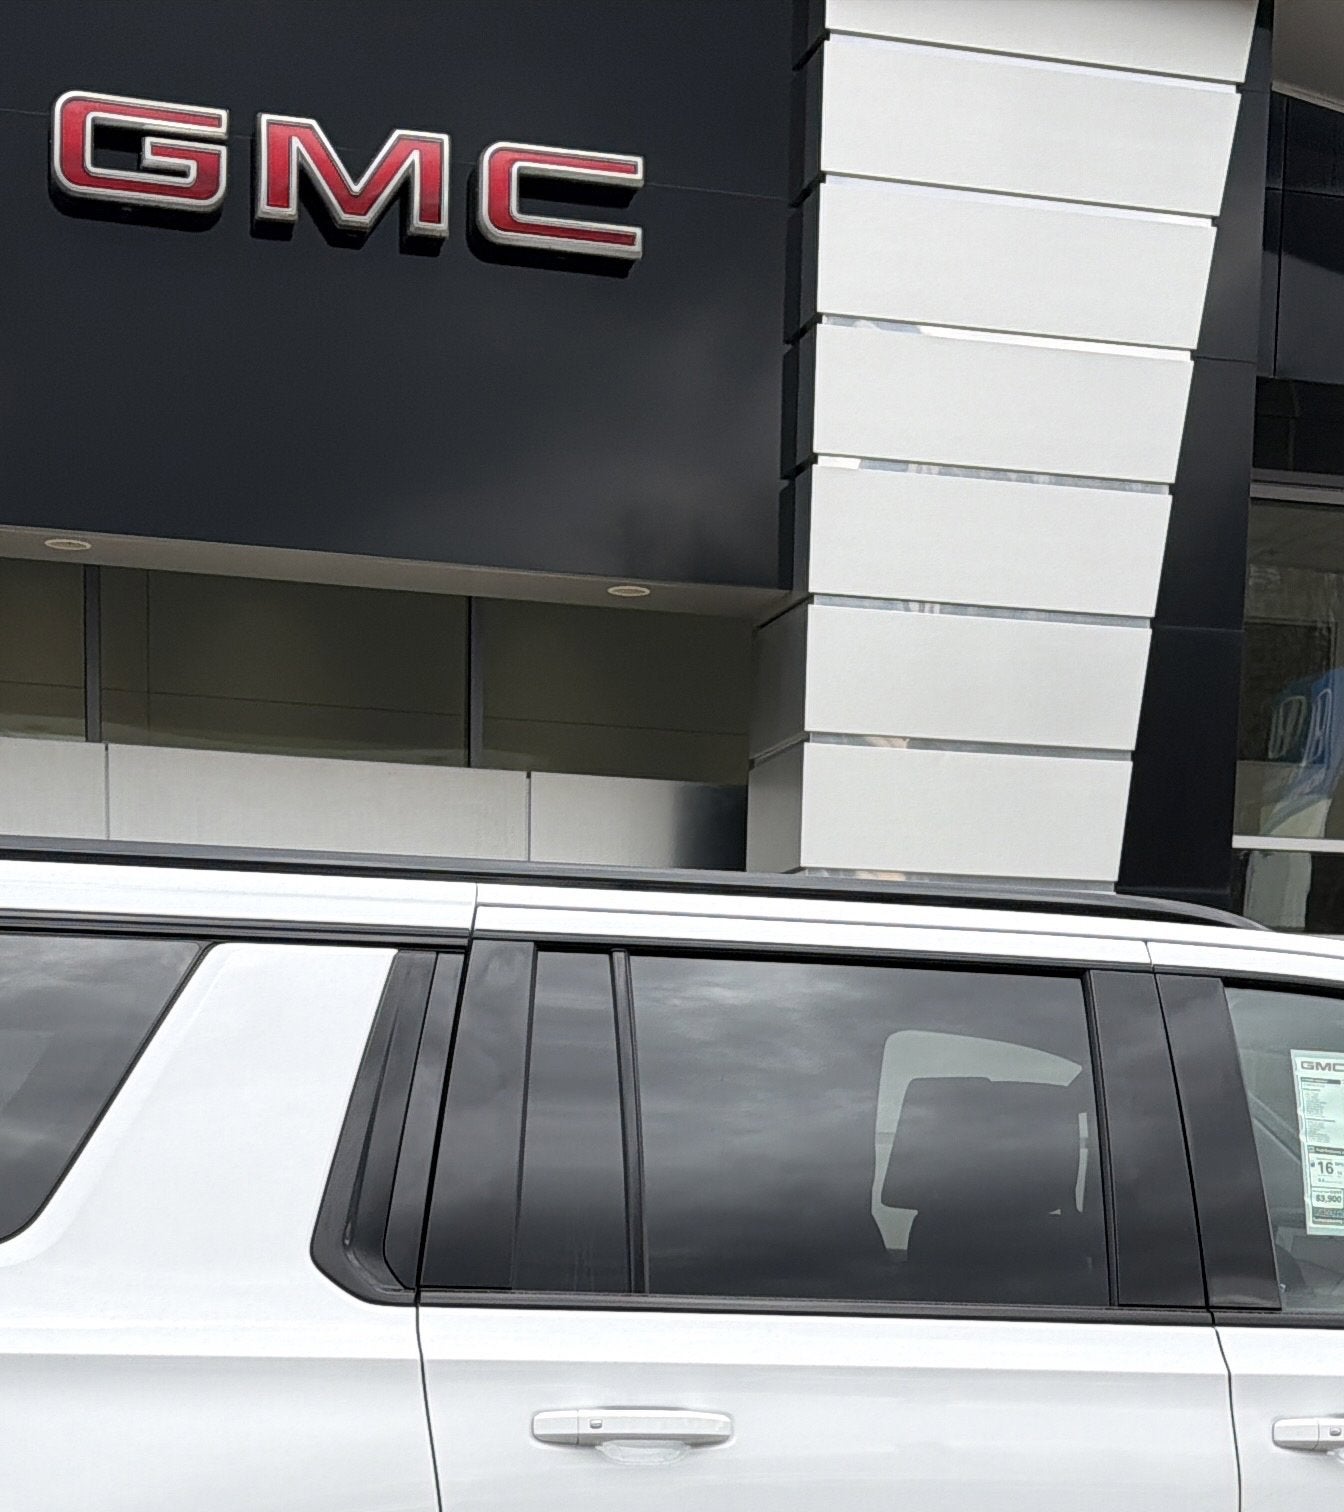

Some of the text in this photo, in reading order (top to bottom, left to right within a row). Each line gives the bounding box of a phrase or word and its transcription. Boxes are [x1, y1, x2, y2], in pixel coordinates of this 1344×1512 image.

[53, 90, 645, 260] GMC
[1317, 1161, 1334, 1174] 16
[1316, 1194, 1342, 1203] $3,900
